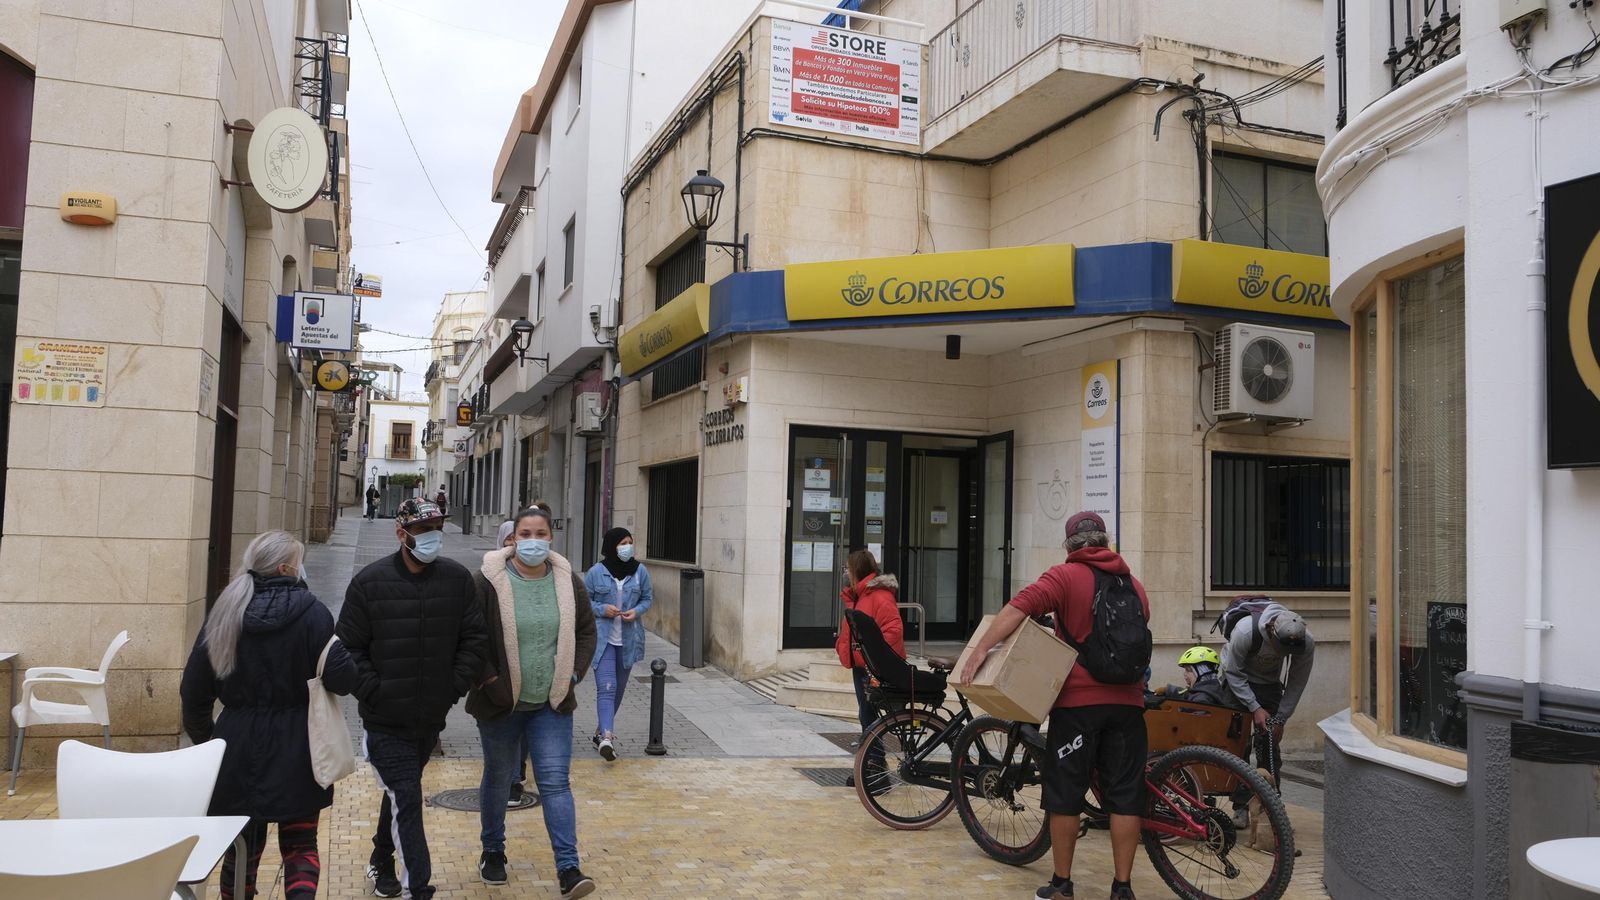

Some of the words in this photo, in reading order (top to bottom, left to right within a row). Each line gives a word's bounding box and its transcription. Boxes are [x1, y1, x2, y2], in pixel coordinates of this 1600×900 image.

[811, 44, 851, 56] OPORTUNIDADES
[829, 32, 886, 56] STORE
[814, 55, 827, 63] Más
[836, 57, 852, 67] 300
[800, 71, 812, 79] Más
[823, 73, 845, 84] 1.000
[800, 95, 827, 106] Solicite
[837, 101, 868, 112] Hipoteca
[868, 105, 891, 116] 100%
[878, 275, 1005, 305] CORREOS
[1271, 273, 1331, 308] CORR
[301, 331, 329, 339] Apuestas
[1087, 399, 1108, 408] Correos
